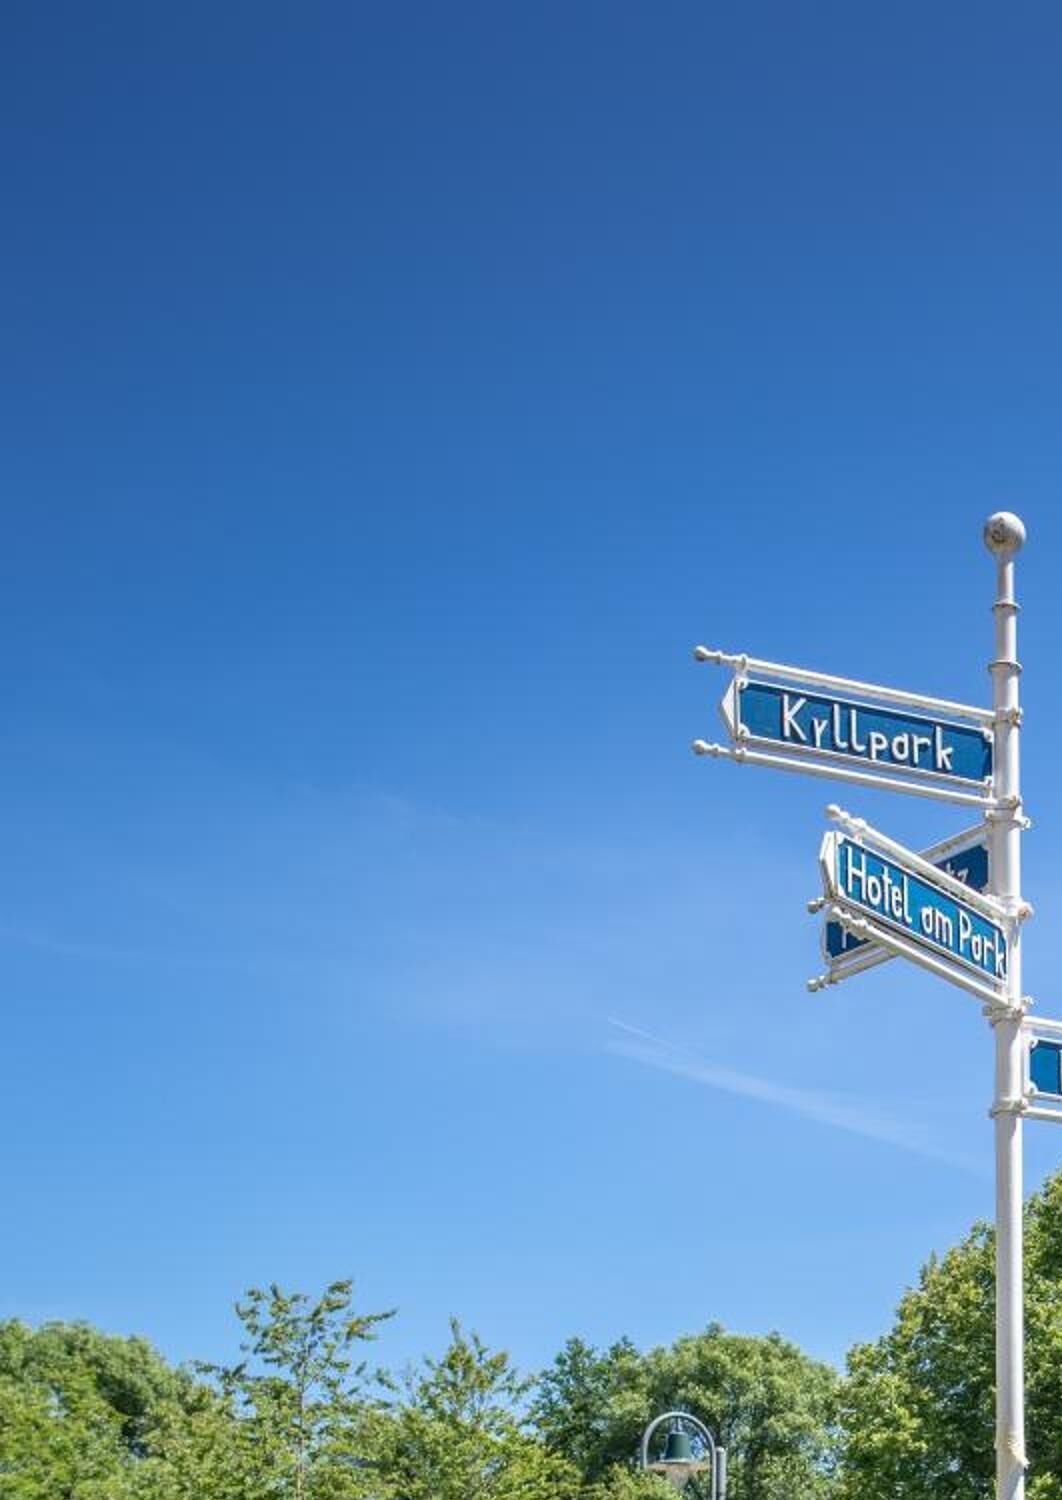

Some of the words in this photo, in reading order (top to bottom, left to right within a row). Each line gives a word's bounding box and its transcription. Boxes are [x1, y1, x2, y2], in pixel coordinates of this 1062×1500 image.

[782, 694, 953, 770] Kyllpark
[846, 846, 913, 924] Hotel
[921, 904, 952, 947] am
[959, 909, 1006, 977] Park
